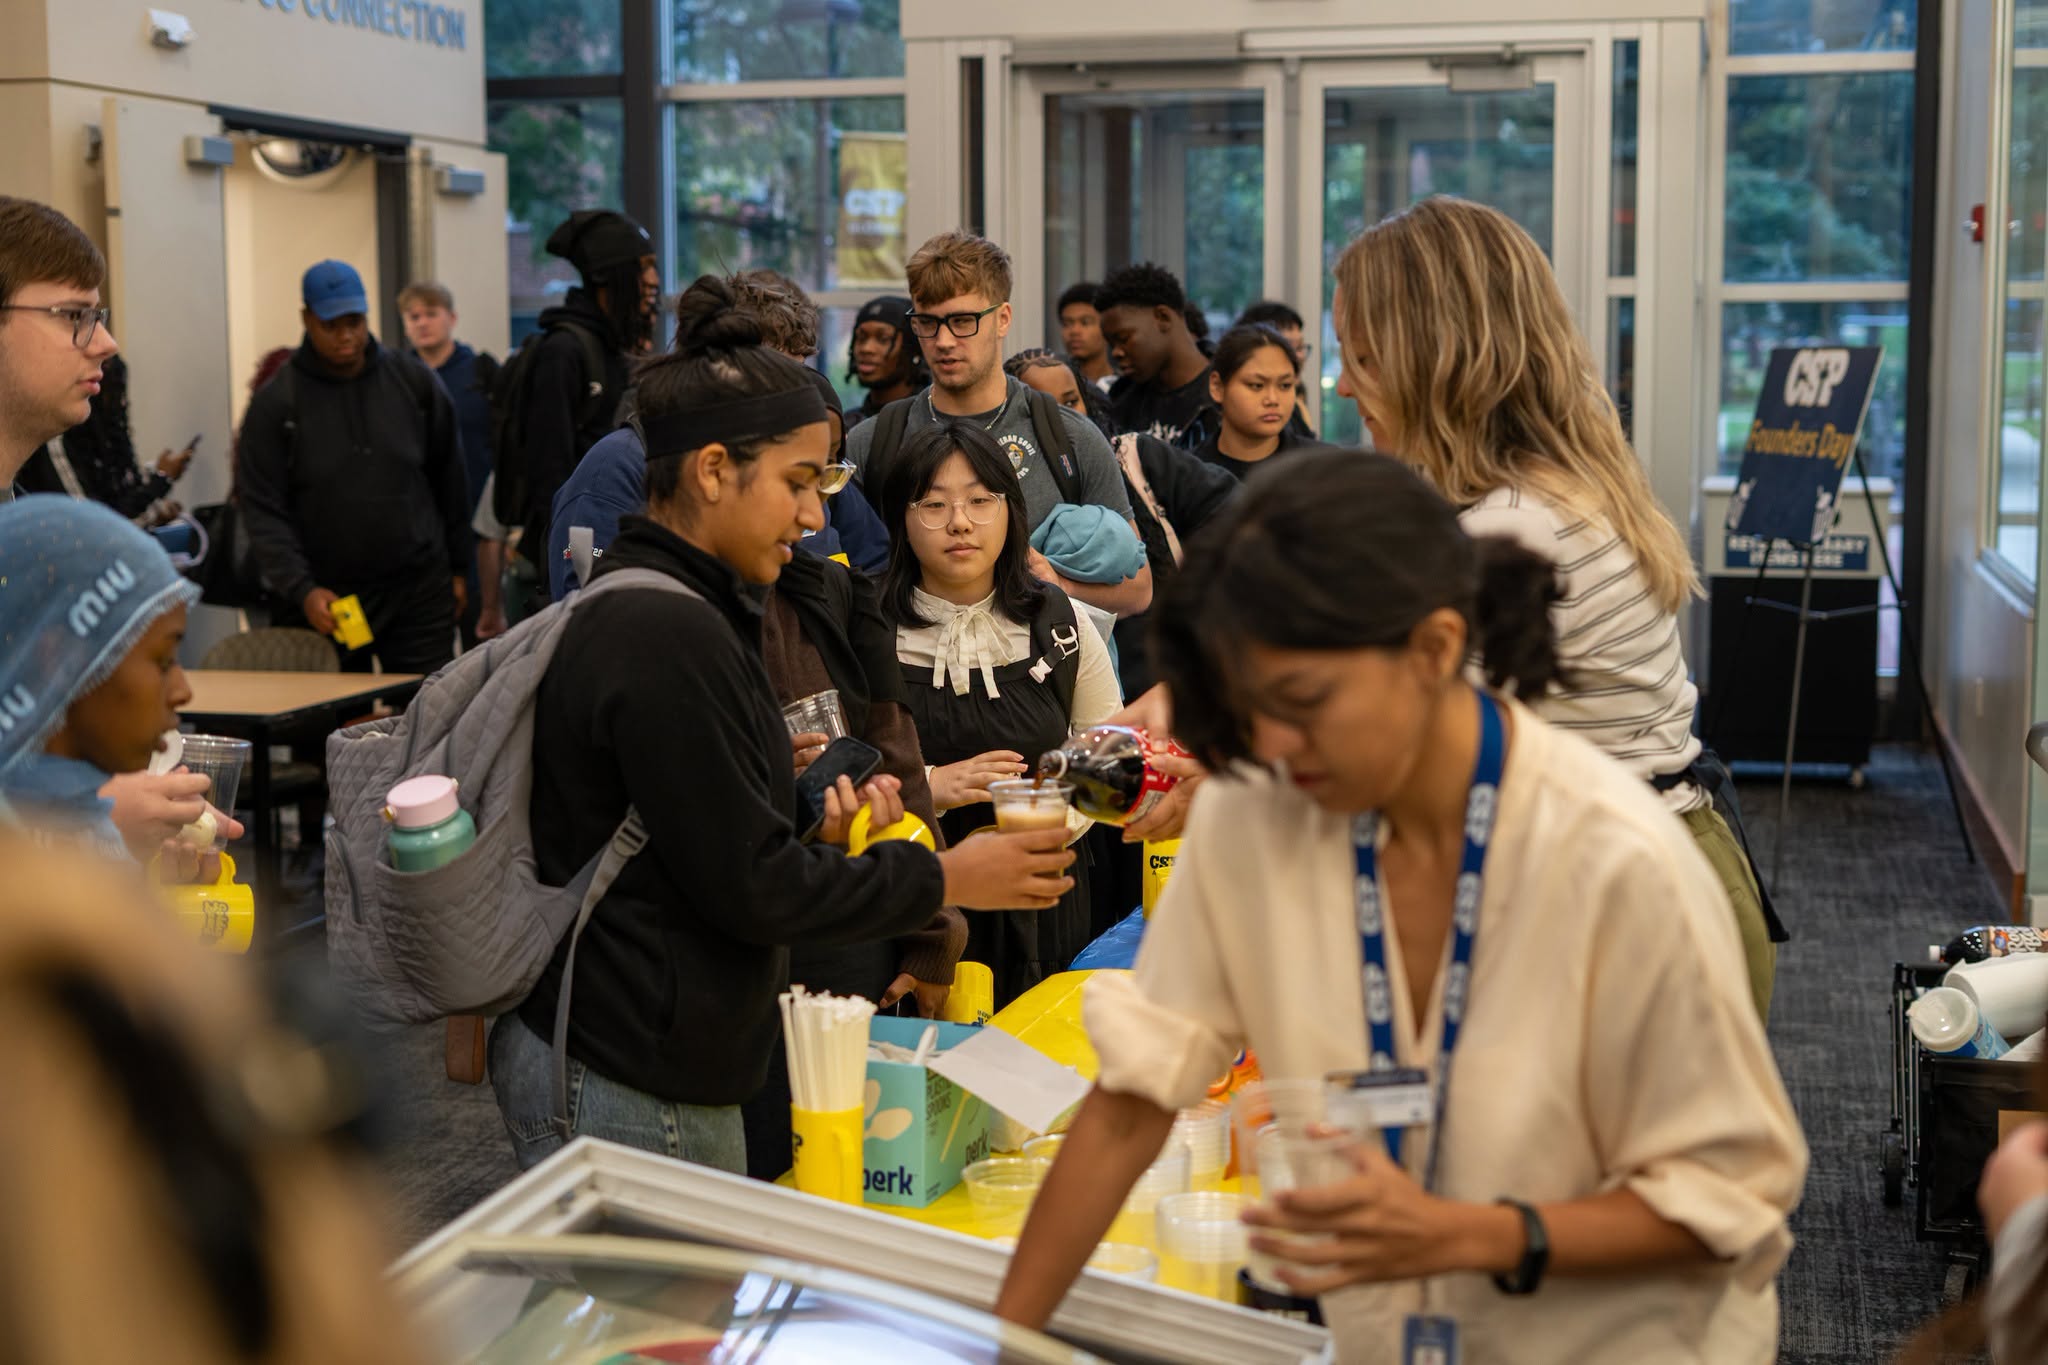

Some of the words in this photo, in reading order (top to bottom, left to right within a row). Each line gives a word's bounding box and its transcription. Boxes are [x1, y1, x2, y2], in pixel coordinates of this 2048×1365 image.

[1784, 348, 1850, 407] CSP
[1747, 419, 1821, 458] Founders
[1816, 422, 1856, 470] Day
